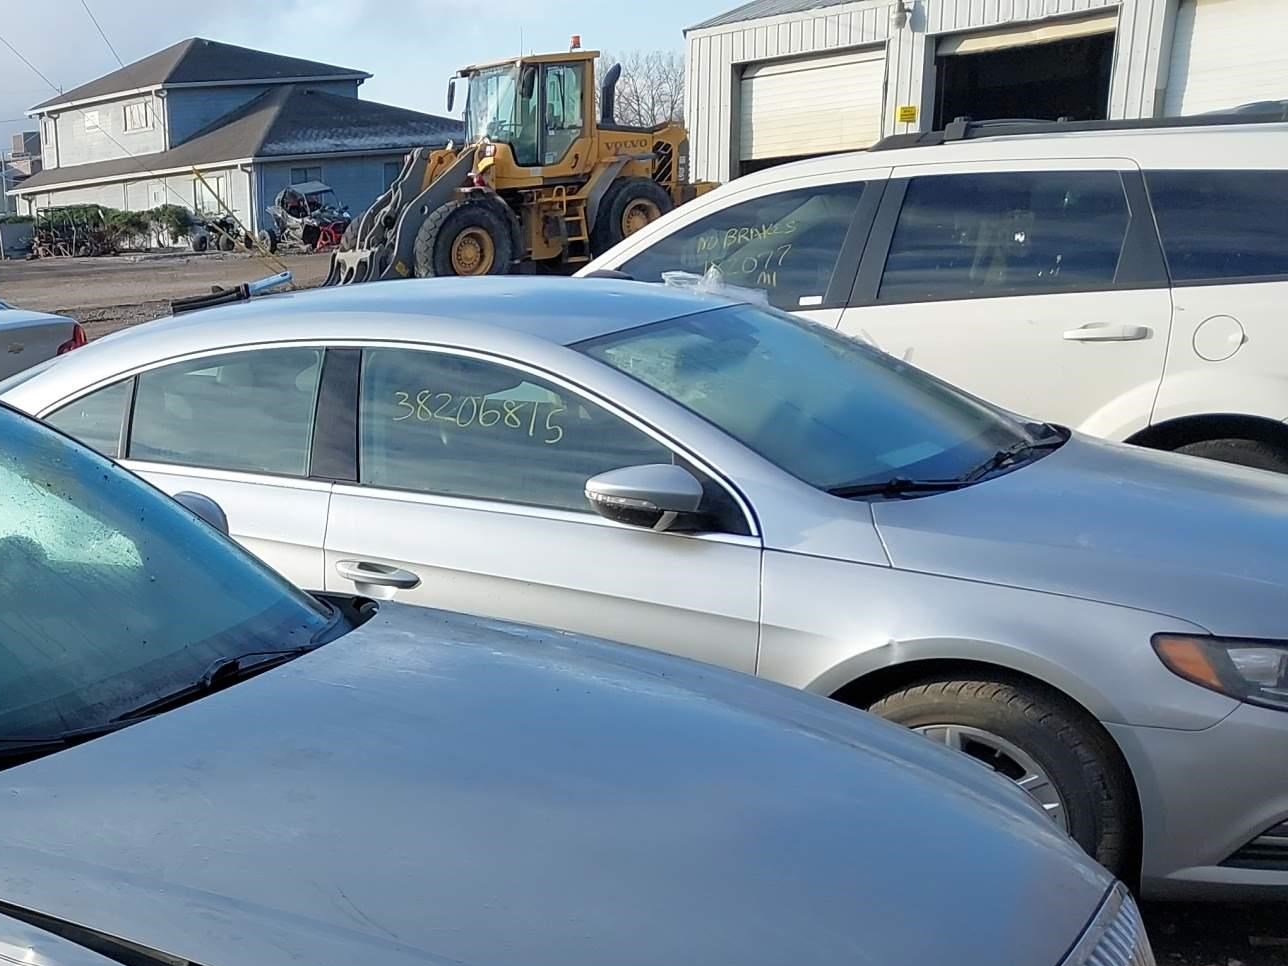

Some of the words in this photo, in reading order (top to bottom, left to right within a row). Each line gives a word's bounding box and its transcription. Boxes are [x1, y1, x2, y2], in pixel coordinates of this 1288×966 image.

[604, 139, 648, 150] VOLVO
[696, 236, 719, 254] NO
[723, 220, 797, 249] BRAKES
[392, 390, 564, 444] 38206815
